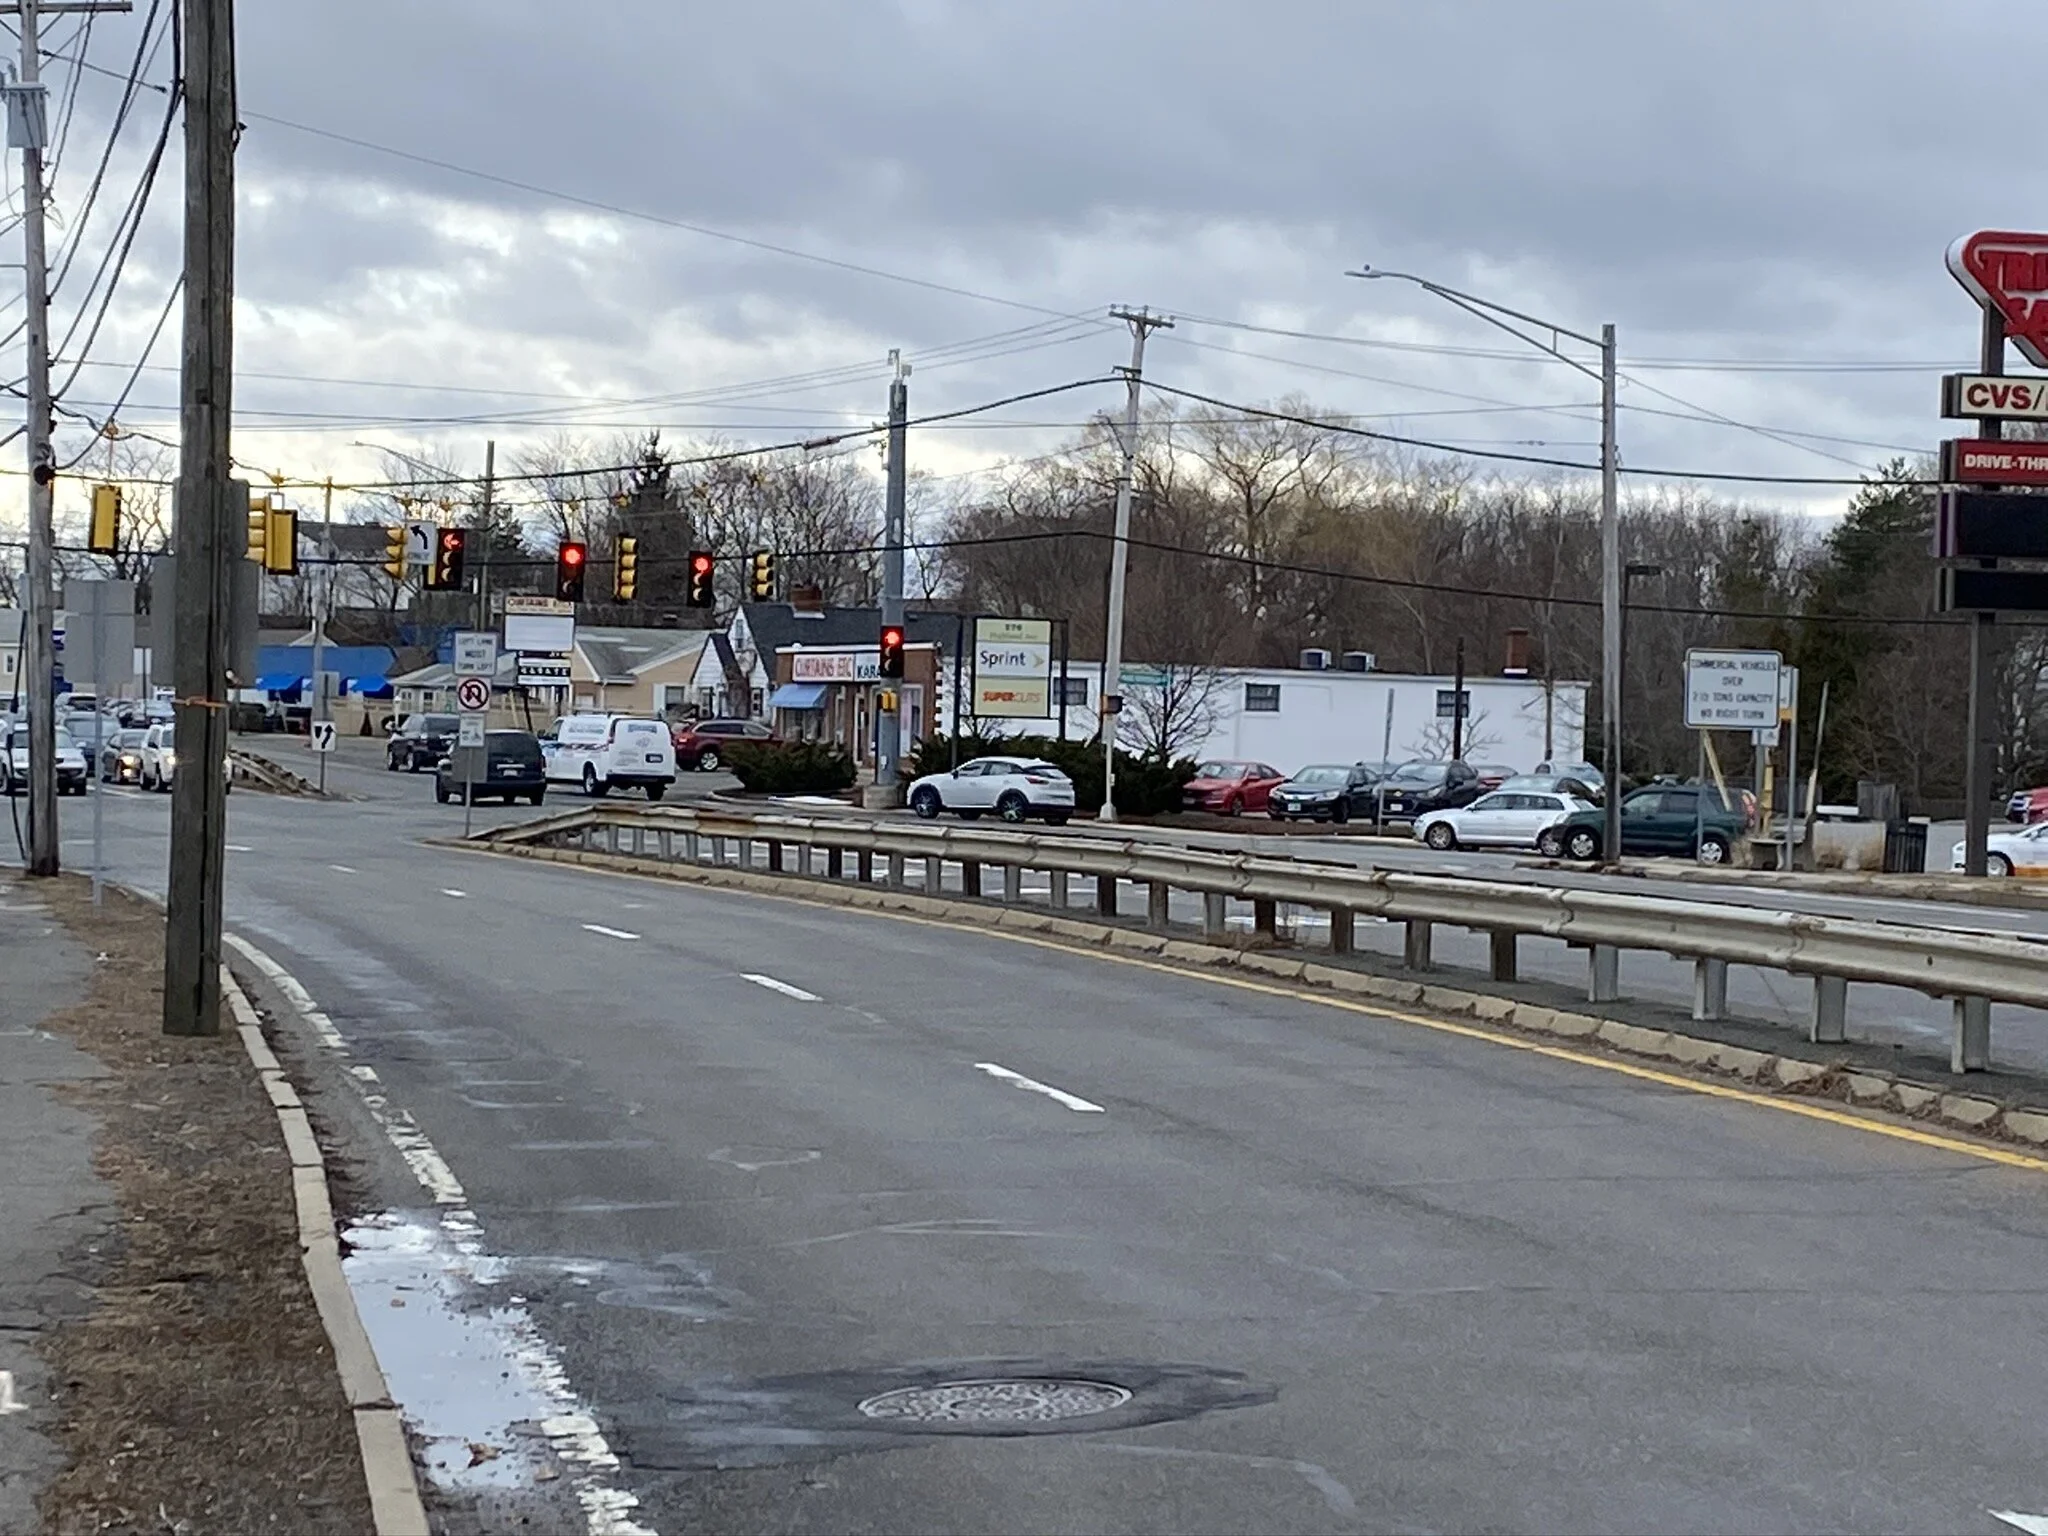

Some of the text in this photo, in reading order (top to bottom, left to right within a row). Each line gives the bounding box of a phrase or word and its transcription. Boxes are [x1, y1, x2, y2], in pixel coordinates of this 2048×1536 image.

[1966, 382, 2048, 410] CVS/
[980, 650, 1026, 668] Sprint
[796, 657, 834, 677] CURTAINS
[1691, 660, 1777, 671] COMMERCIAL VEHICLES
[1722, 676, 1743, 686] OVER
[983, 691, 1041, 702] SUPERCUTS
[1713, 692, 1733, 702] TONS
[1736, 693, 1773, 703] CAPACITY
[1701, 708, 1764, 719] NO RIGHT TURN
